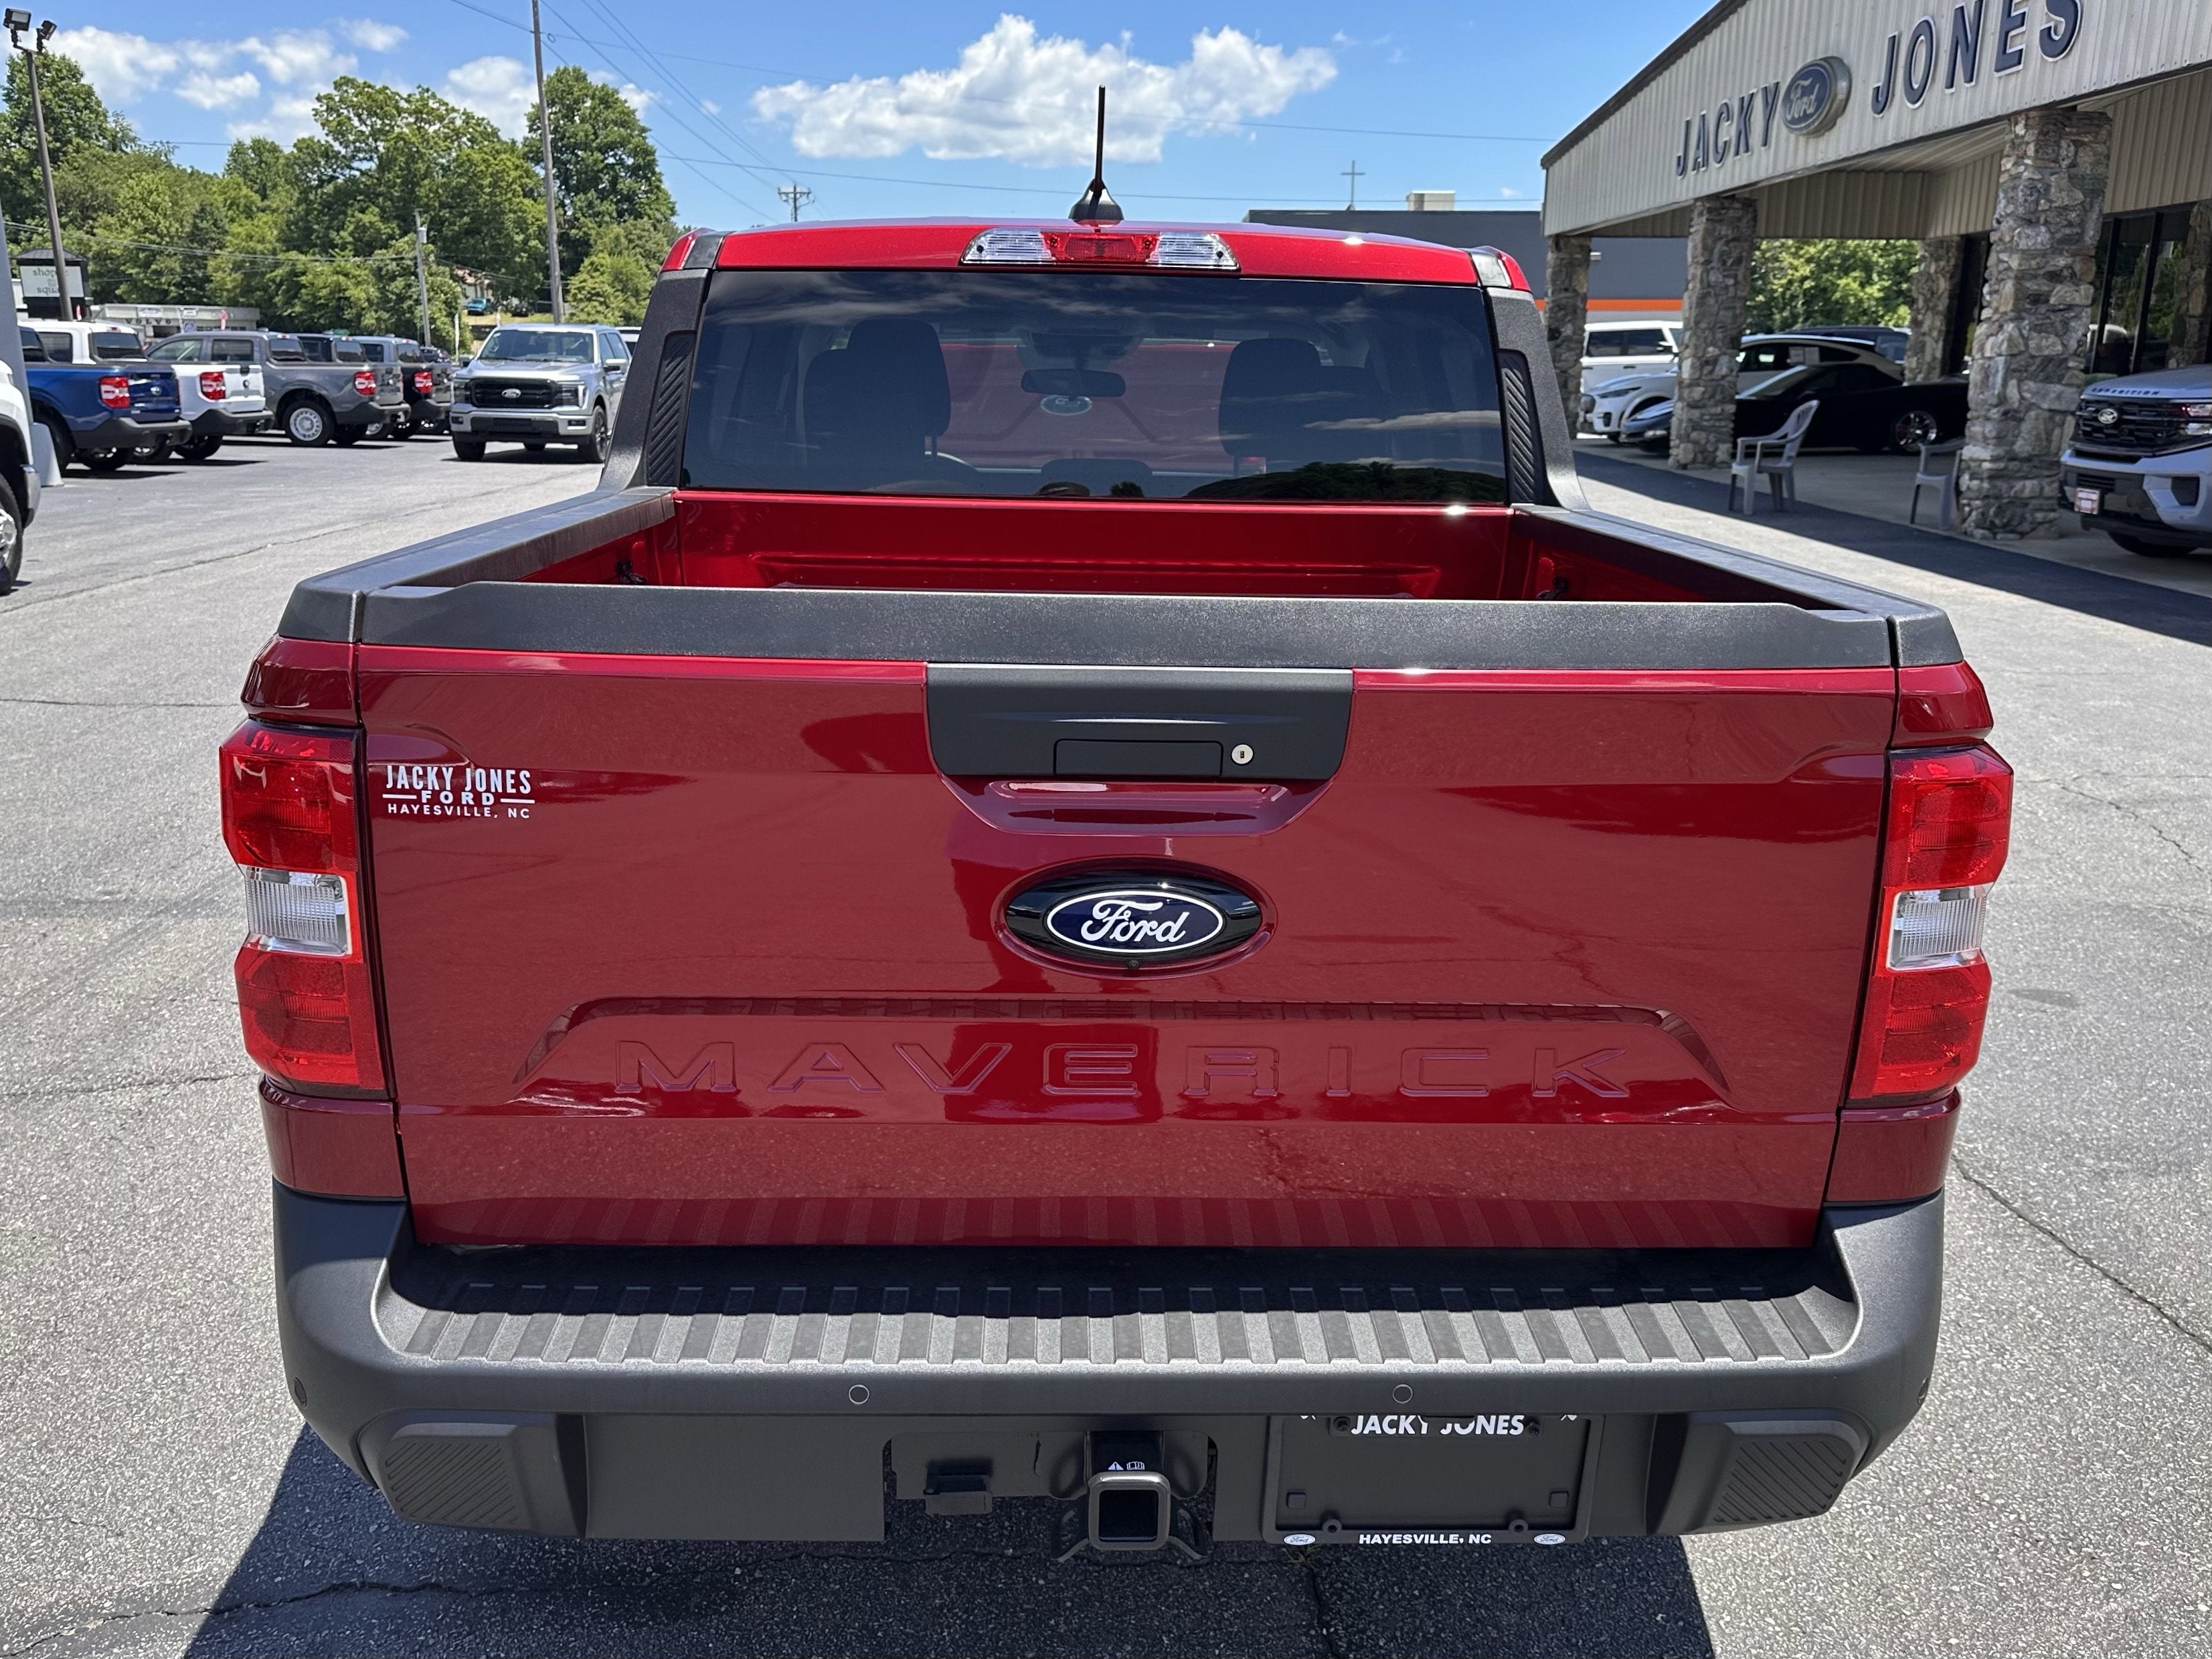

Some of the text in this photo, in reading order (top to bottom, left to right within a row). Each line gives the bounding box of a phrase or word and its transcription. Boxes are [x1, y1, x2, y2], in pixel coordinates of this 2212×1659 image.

[1677, 0, 2081, 178] JACKY JONES
[1786, 78, 1820, 121] Ford
[386, 765, 531, 794] JACKY JONES
[388, 804, 530, 818] HAYESVILLE, NC
[421, 790, 495, 806] FORD
[1081, 899, 1190, 942] Ford
[614, 1039, 1630, 1098] MAVERICK
[1351, 1415, 1525, 1435] JACKY JONES
[1359, 1534, 1492, 1545] HAYESVILLE, NC
